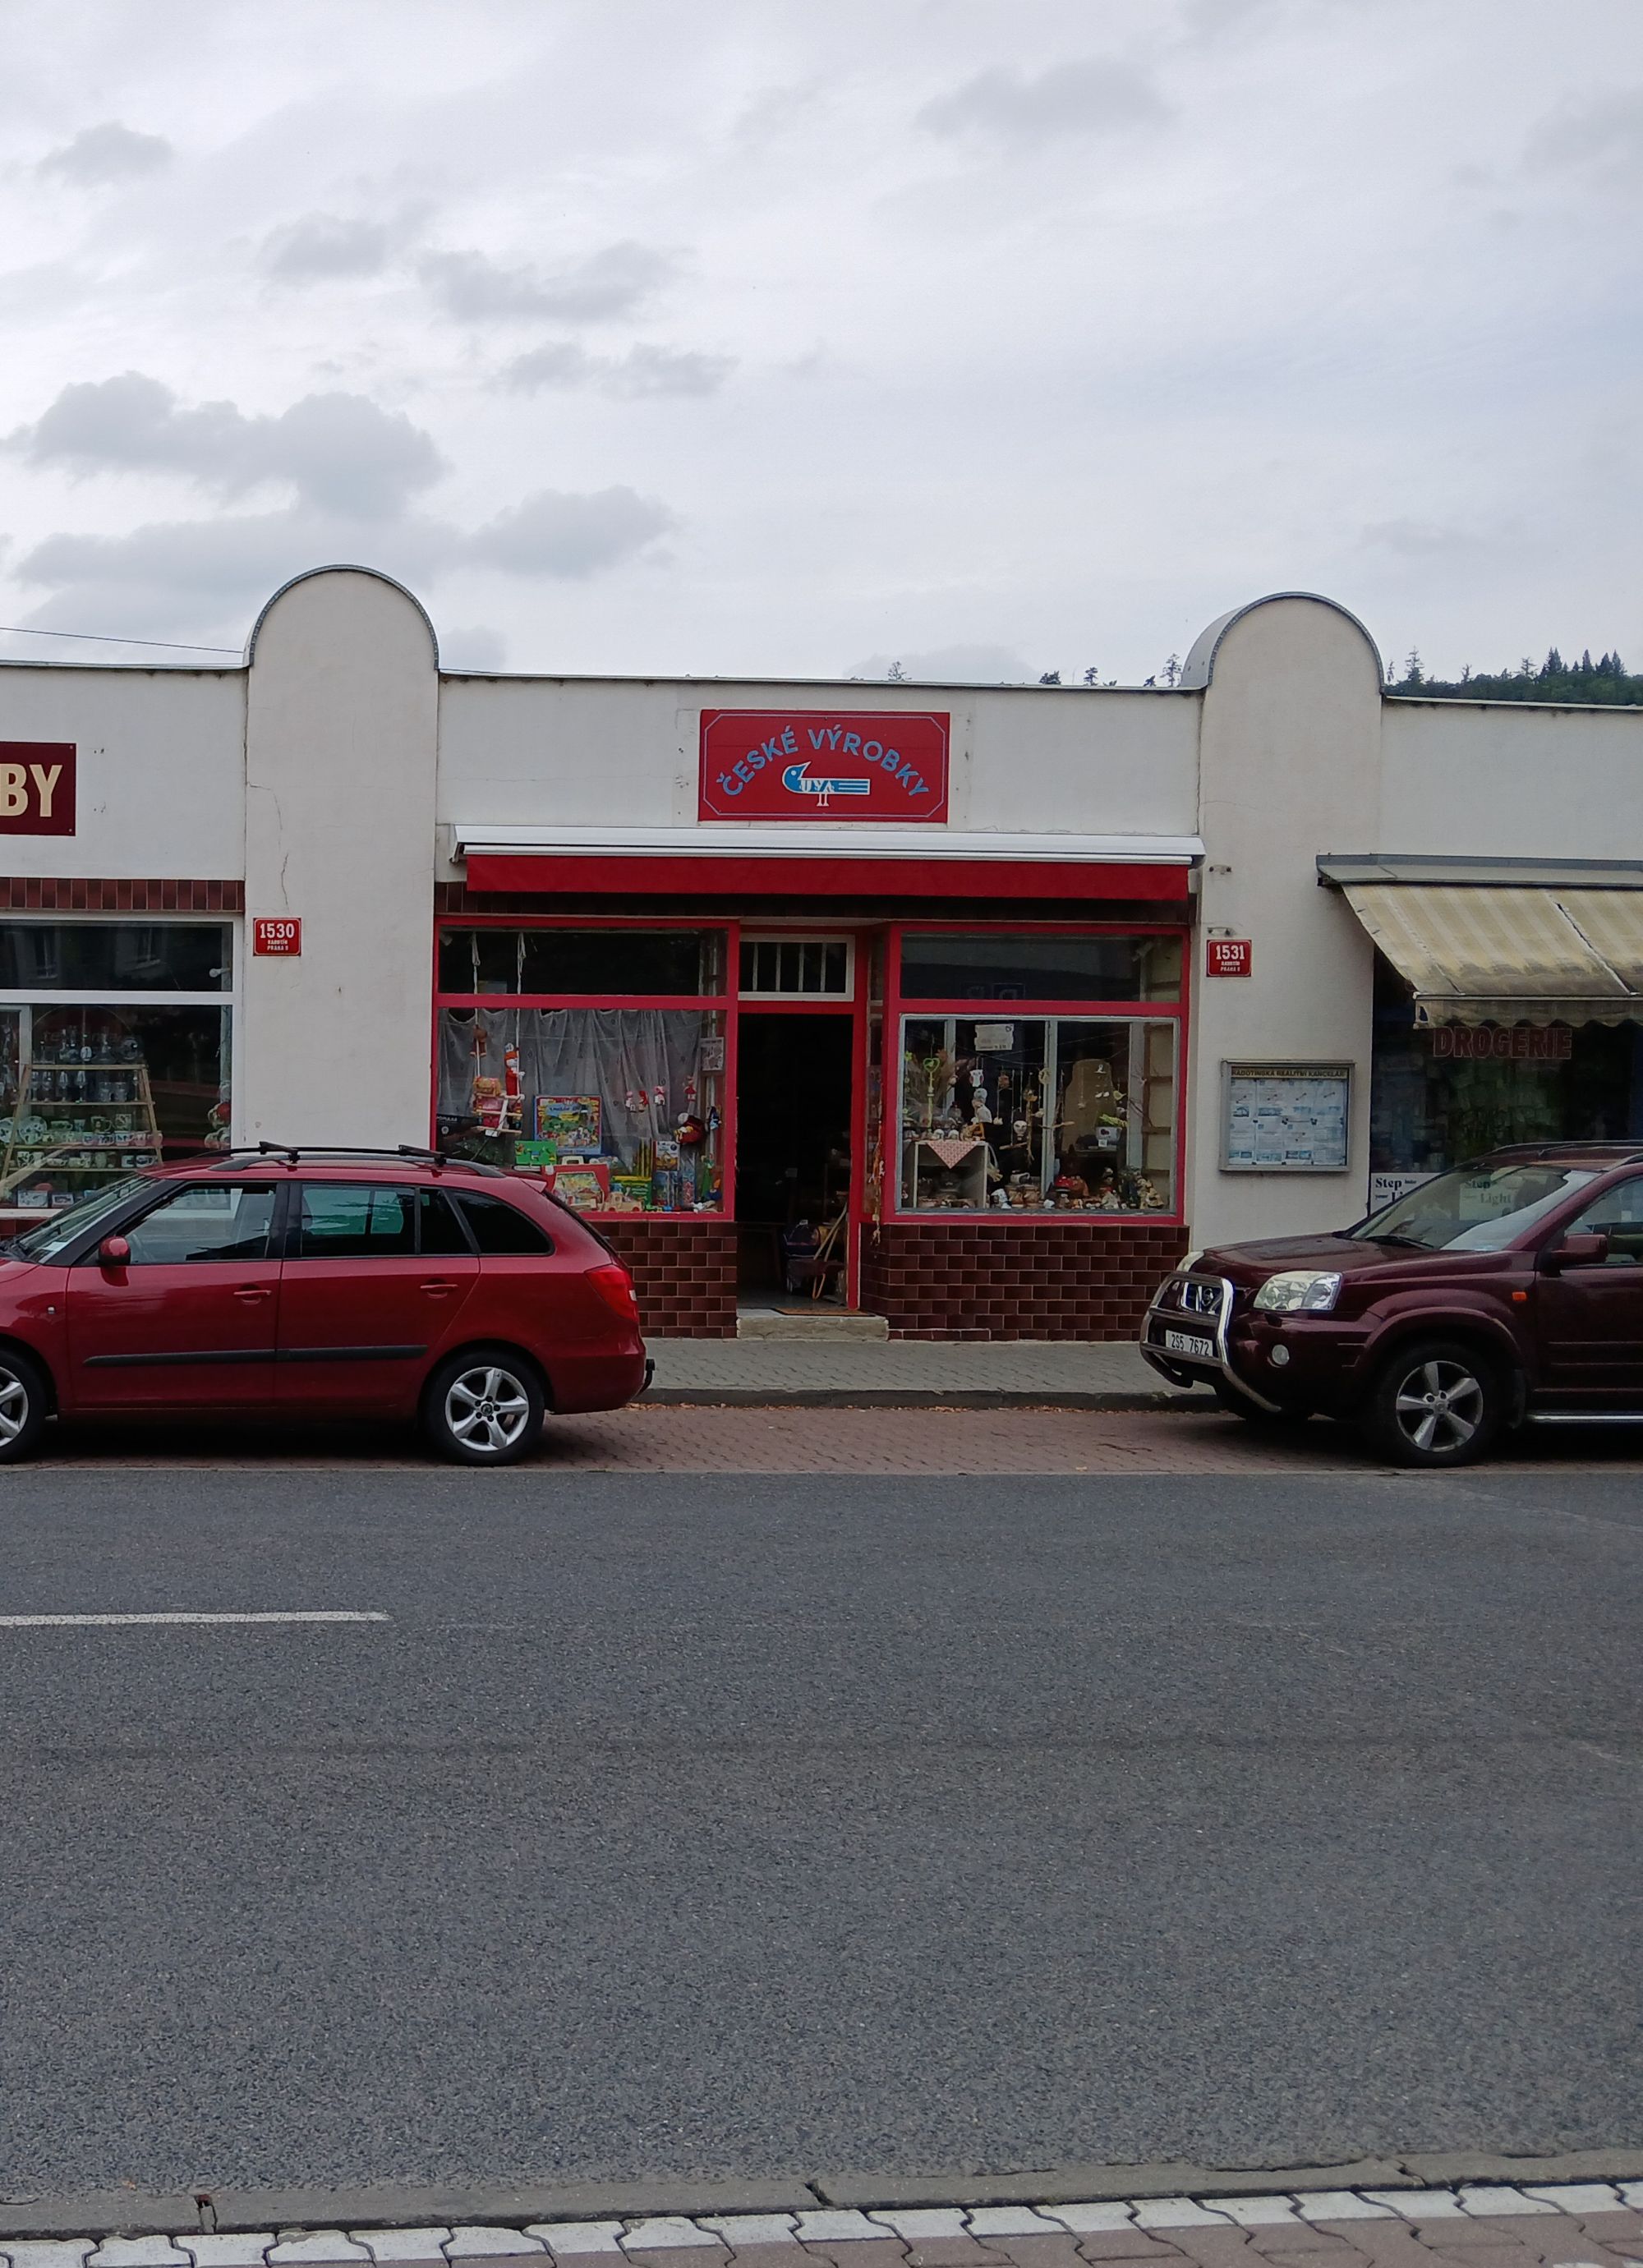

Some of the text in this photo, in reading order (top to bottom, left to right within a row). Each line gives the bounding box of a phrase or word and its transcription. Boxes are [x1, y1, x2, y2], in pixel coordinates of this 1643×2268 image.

[716, 724, 929, 796] ČESKÉ VÝROBKY
[0, 763, 63, 817] BY
[260, 922, 295, 938] 1530
[1216, 945, 1245, 960] 1531
[1434, 1027, 1572, 1060] DROGERIE
[1375, 1177, 1402, 1191] Step
[1480, 1193, 1512, 1206] Light
[1171, 1333, 1209, 1356] 2S5 7672
